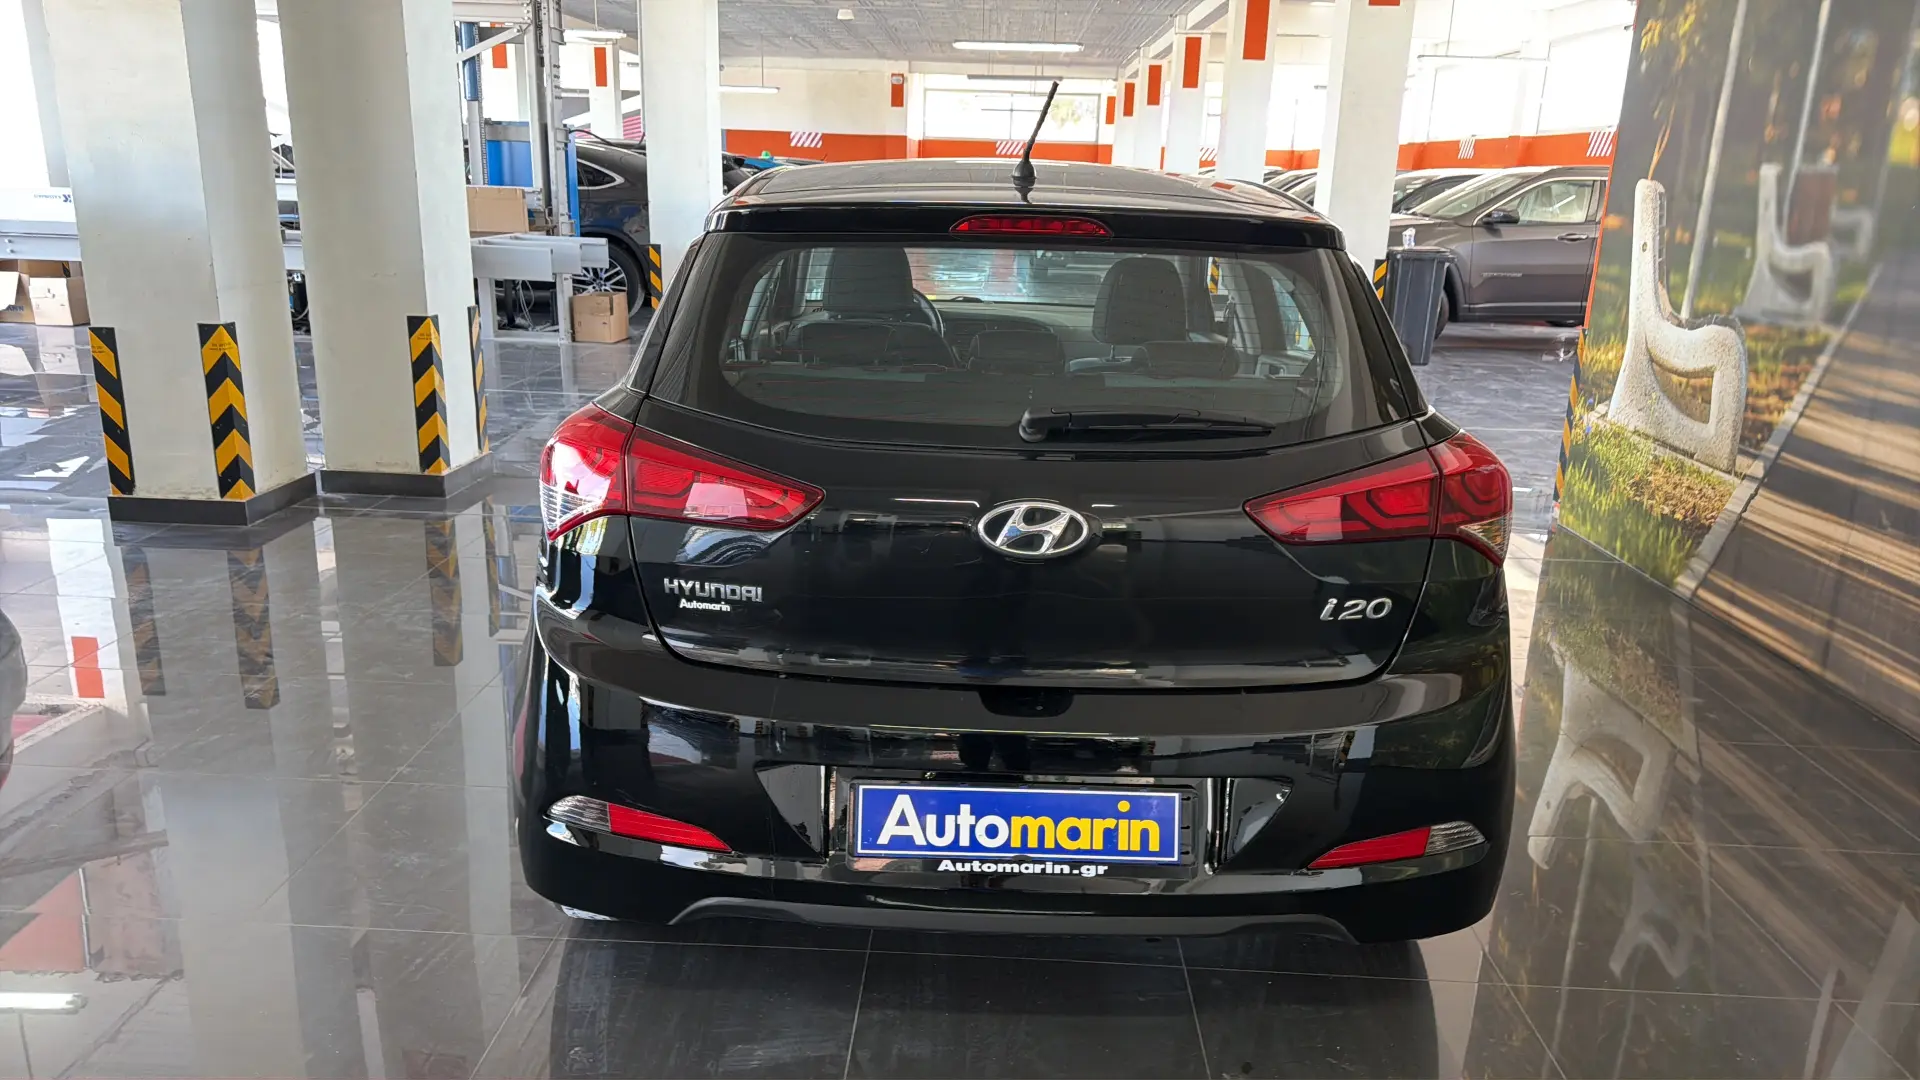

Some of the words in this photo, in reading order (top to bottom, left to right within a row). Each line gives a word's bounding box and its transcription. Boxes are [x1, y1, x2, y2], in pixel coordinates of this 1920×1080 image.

[663, 578, 763, 602] HYUNDAI
[679, 597, 731, 612] Automarin
[1319, 597, 1393, 621] i20
[875, 793, 1161, 852] Automarin
[937, 859, 1109, 877] Automarin.gr
